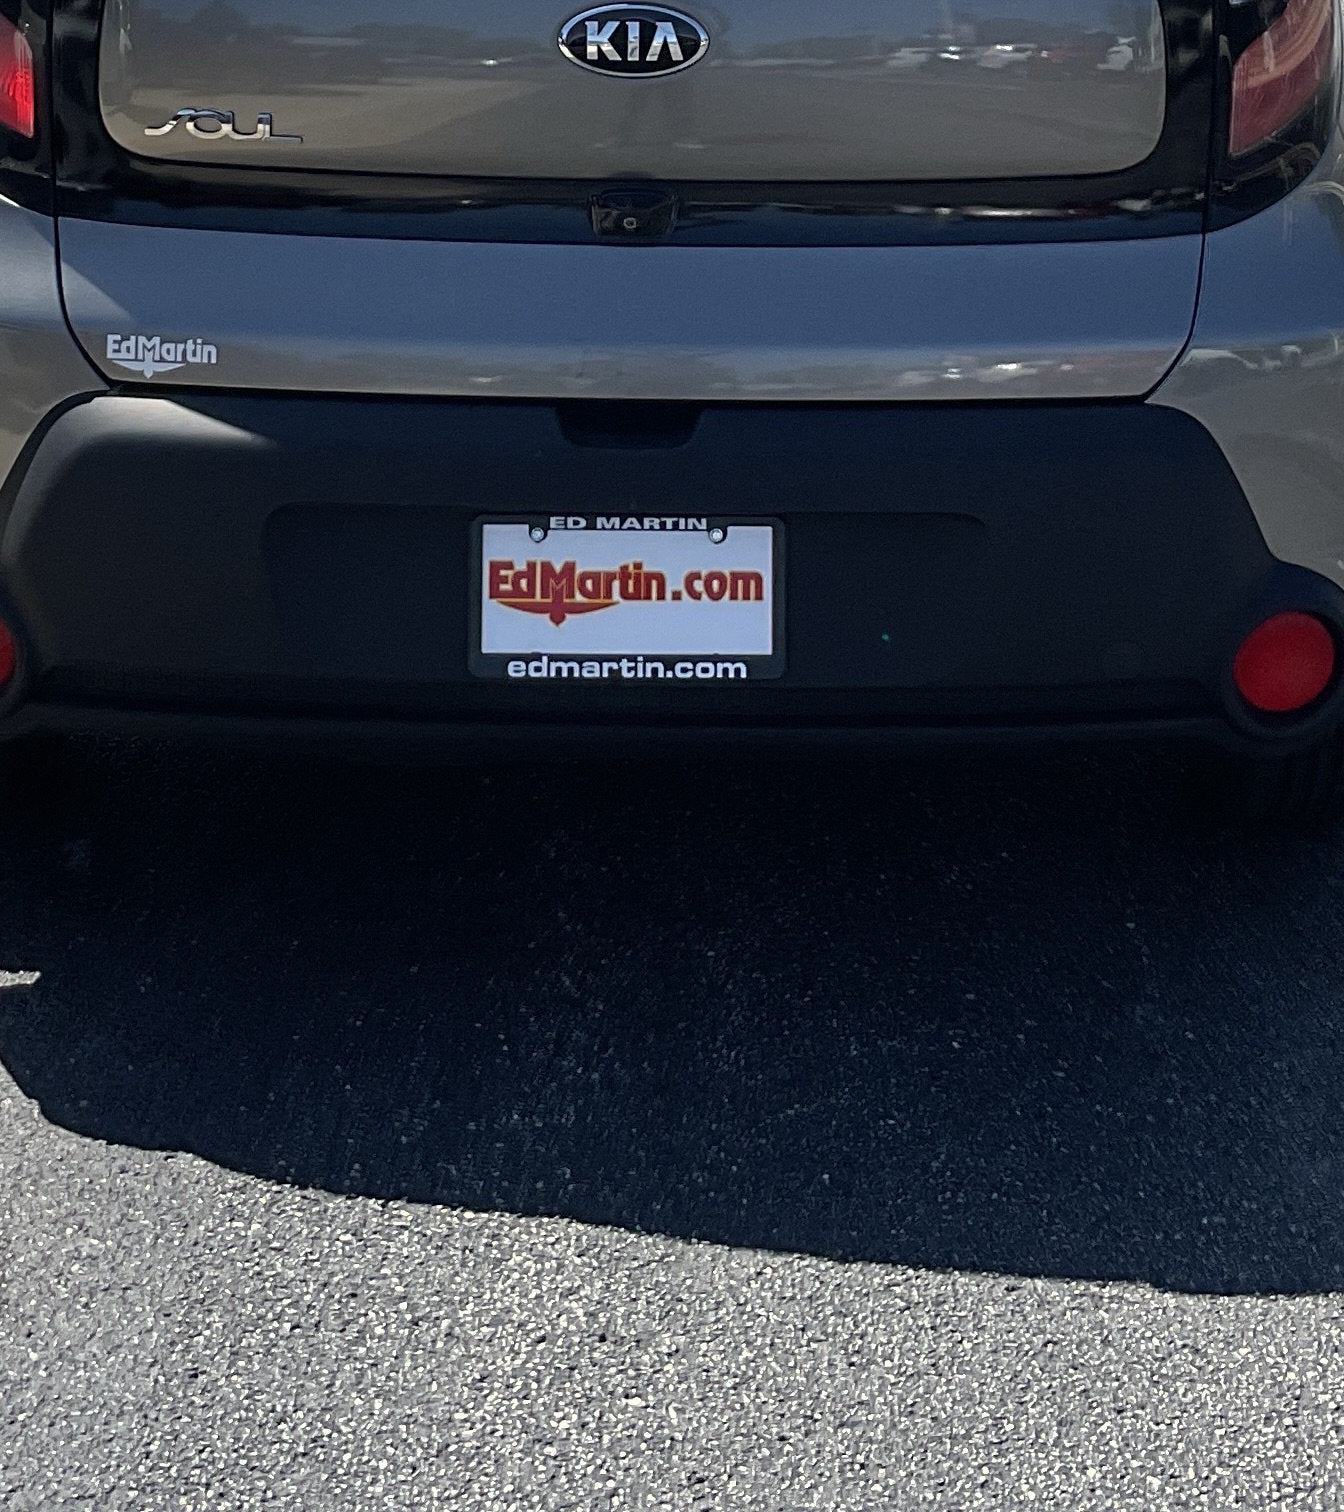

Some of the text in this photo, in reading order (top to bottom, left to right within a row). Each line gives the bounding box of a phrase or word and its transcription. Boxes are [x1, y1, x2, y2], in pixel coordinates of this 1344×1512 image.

[584, 20, 685, 62] KIA
[144, 107, 303, 143] SOUL
[549, 516, 707, 530] ED MARTIN
[488, 560, 764, 601] EdMartin.com
[507, 655, 747, 679] edmartin.com
